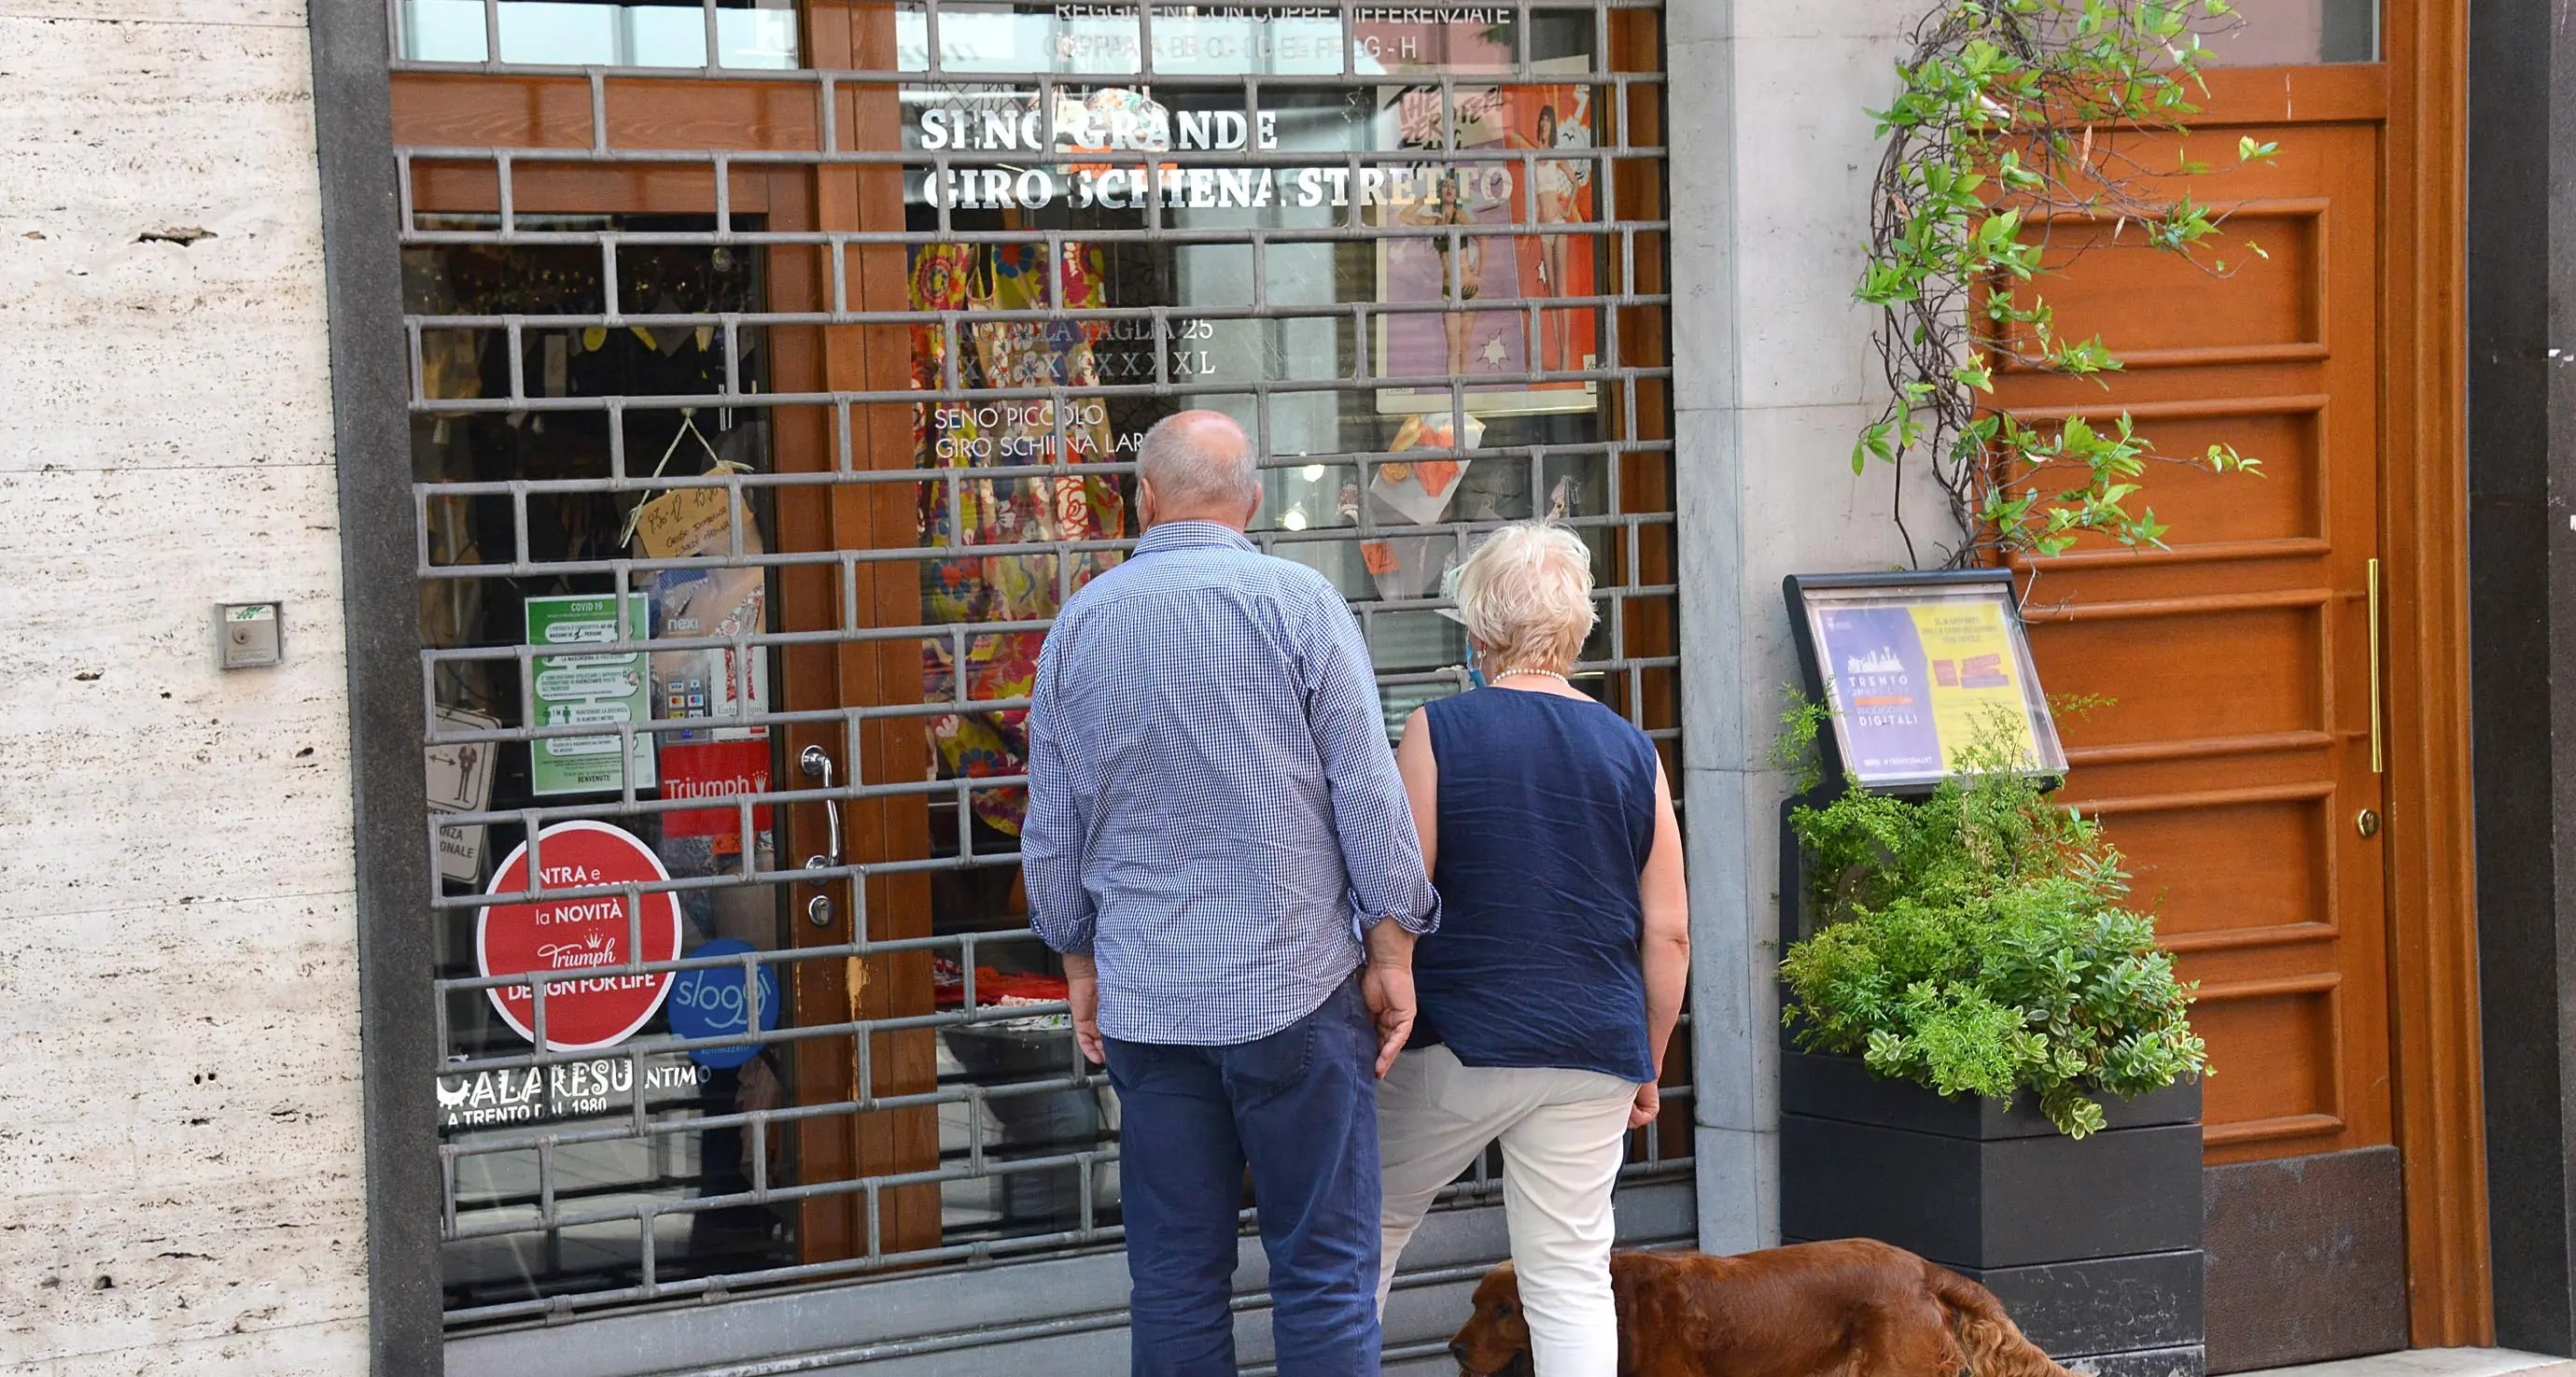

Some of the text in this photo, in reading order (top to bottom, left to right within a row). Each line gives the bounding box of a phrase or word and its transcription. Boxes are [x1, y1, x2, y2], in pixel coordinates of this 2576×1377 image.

[1055, 5, 1187, 21] REGGIENI
[1338, 8, 1511, 24] IFFERENZIATE
[1400, 35, 1418, 58] H
[1073, 109, 1279, 151] GRANDE
[923, 169, 1053, 210] GIRO
[1298, 166, 1513, 207] STRETTO
[1183, 318, 1213, 339] 25
[935, 408, 998, 429] SENO
[935, 438, 991, 459] GIRO
[570, 602, 604, 612] COVID 19
[668, 618, 698, 631] nexi
[1848, 675, 1909, 687] TRENTO
[1858, 714, 1919, 727] DIGITALI
[665, 775, 749, 799] Triumph
[539, 865, 587, 885] NTRA
[591, 869, 601, 881] e
[536, 898, 623, 925] la NOVITÀ
[538, 937, 616, 968] Triumph
[508, 974, 655, 1001] DEIGN FOR LIFE
[463, 1104, 529, 1125] TRENTO
[572, 1097, 607, 1114] 1980
